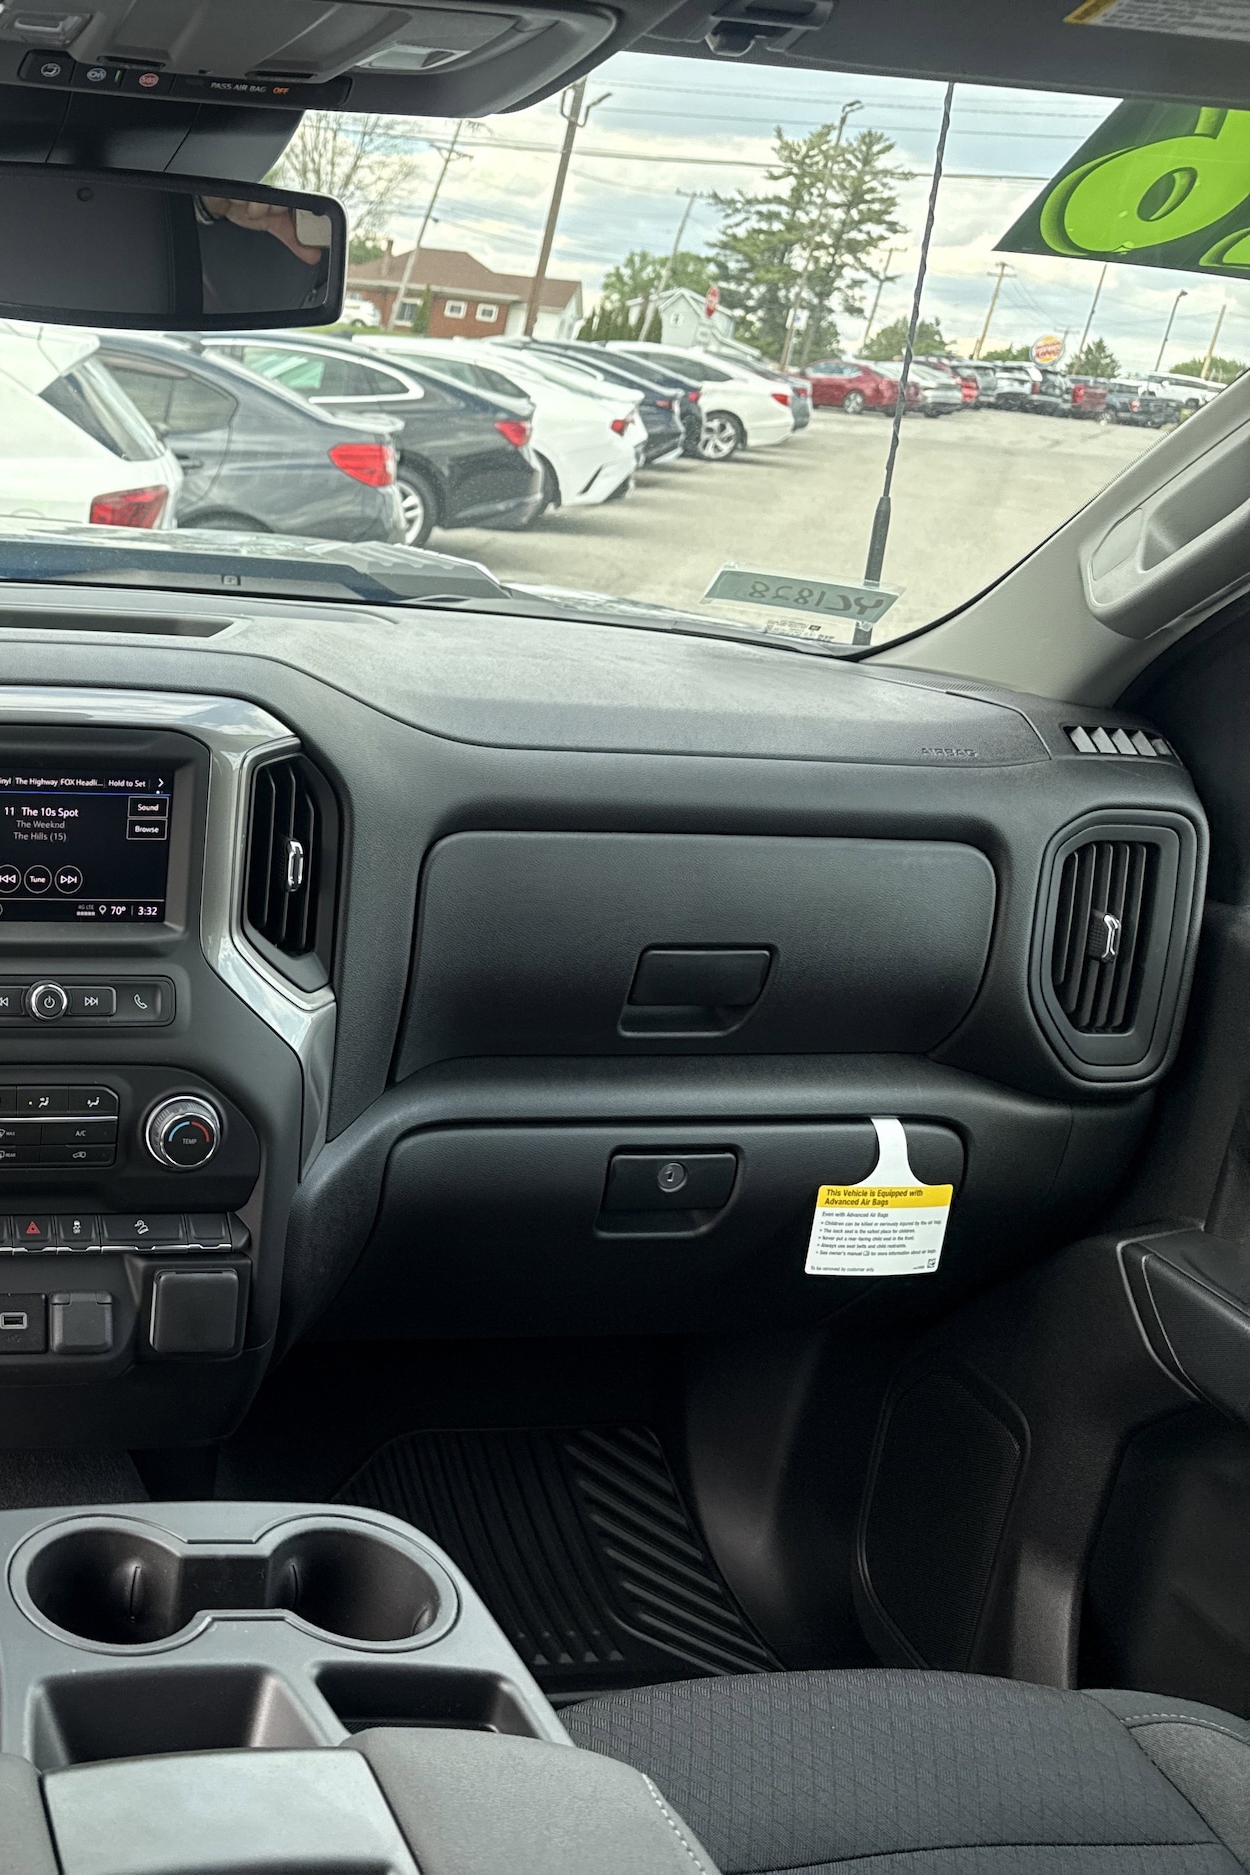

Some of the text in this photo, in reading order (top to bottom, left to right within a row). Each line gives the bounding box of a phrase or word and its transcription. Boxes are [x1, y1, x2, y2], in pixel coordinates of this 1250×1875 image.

[249, 85, 267, 93] BAG
[15, 778, 58, 788] The Highway
[60, 778, 76, 786] FOX
[108, 780, 125, 788] Hold
[134, 780, 146, 788] Set
[4, 806, 78, 819] 11 The 10s Spot
[16, 820, 66, 828] The Weeknd
[134, 825, 160, 834] Browse
[14, 832, 66, 842] The Hills (15)
[30, 876, 46, 884] Tune
[138, 906, 158, 916] 3:32
[827, 1188, 841, 1196] This
[844, 1188, 868, 1196] Vehicle
[878, 1190, 908, 1198] Equipped
[872, 1198, 888, 1207] Bags
